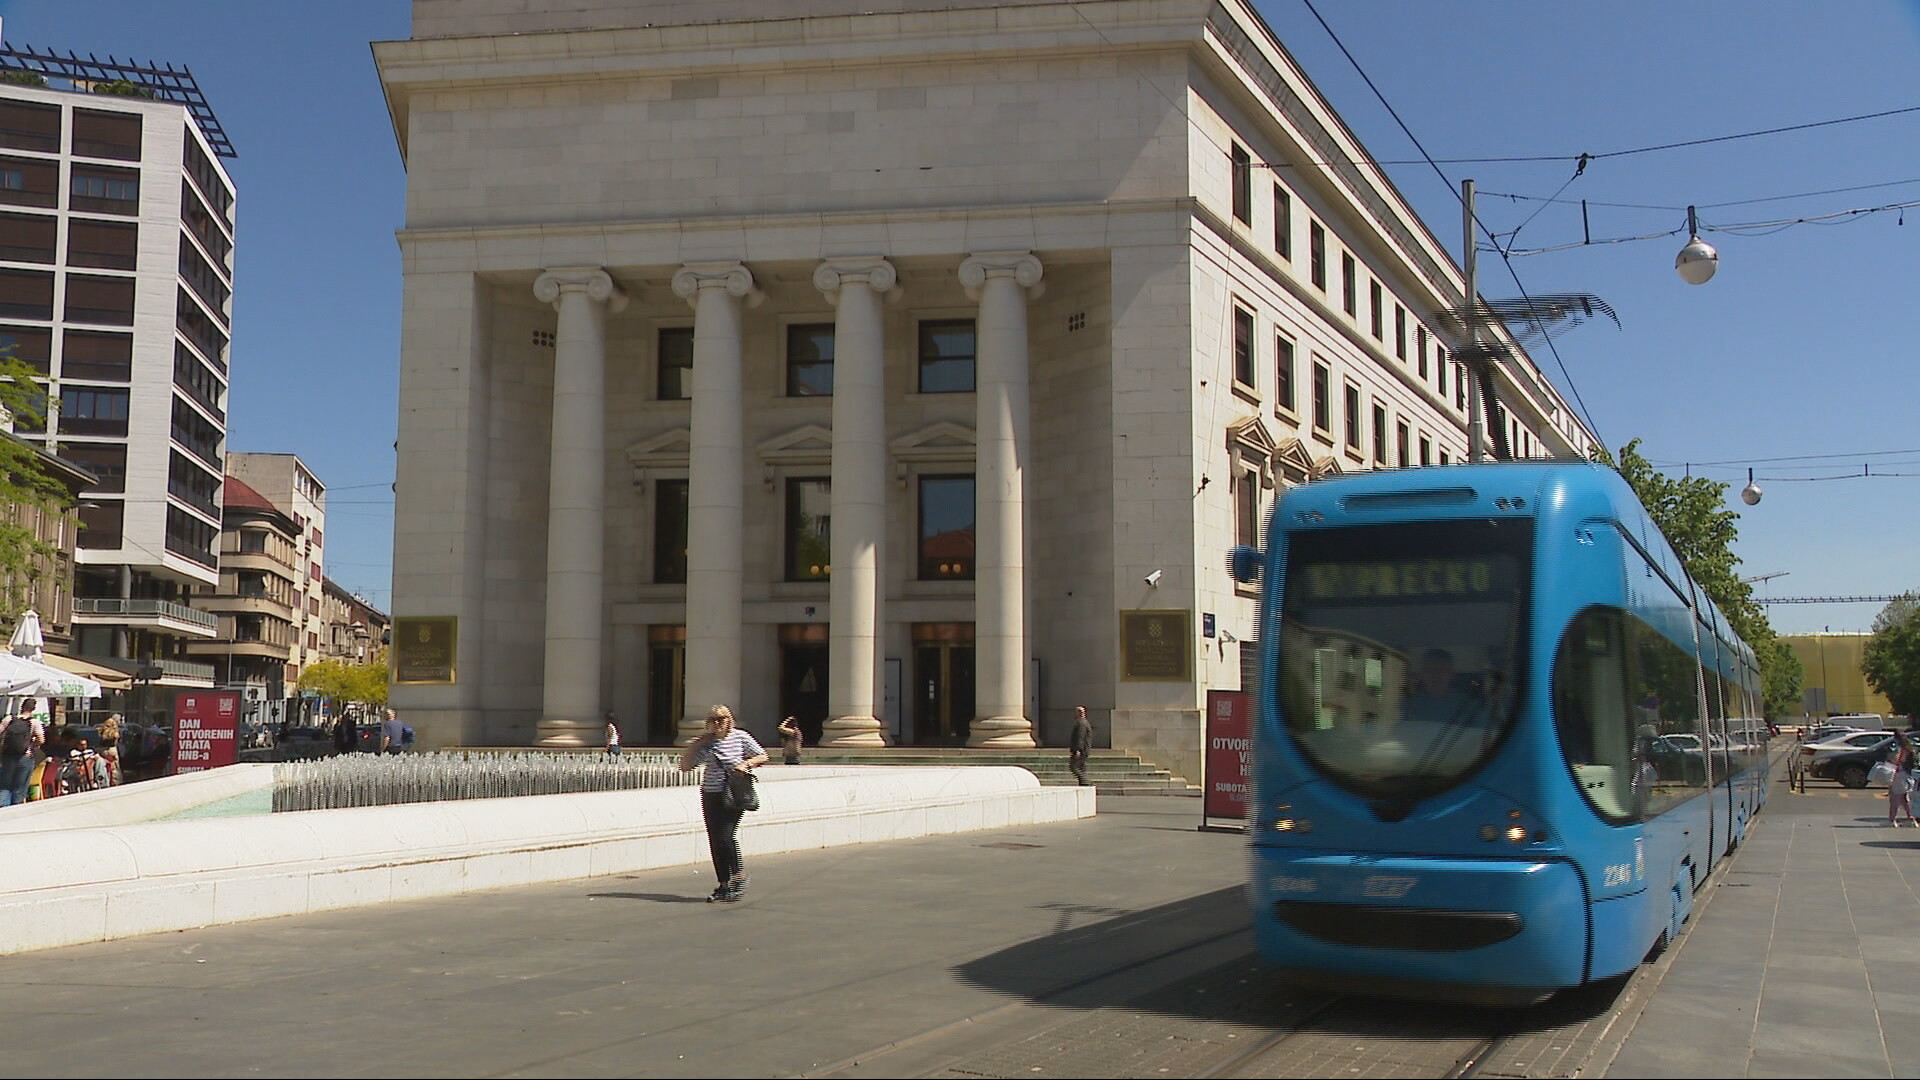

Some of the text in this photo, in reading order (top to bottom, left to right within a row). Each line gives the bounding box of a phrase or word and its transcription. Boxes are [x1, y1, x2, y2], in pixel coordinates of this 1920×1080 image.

[179, 719, 201, 729] DAN
[178, 729, 234, 740] OTVORENIH
[178, 740, 211, 750] VRATA
[177, 750, 210, 760] HNB-a
